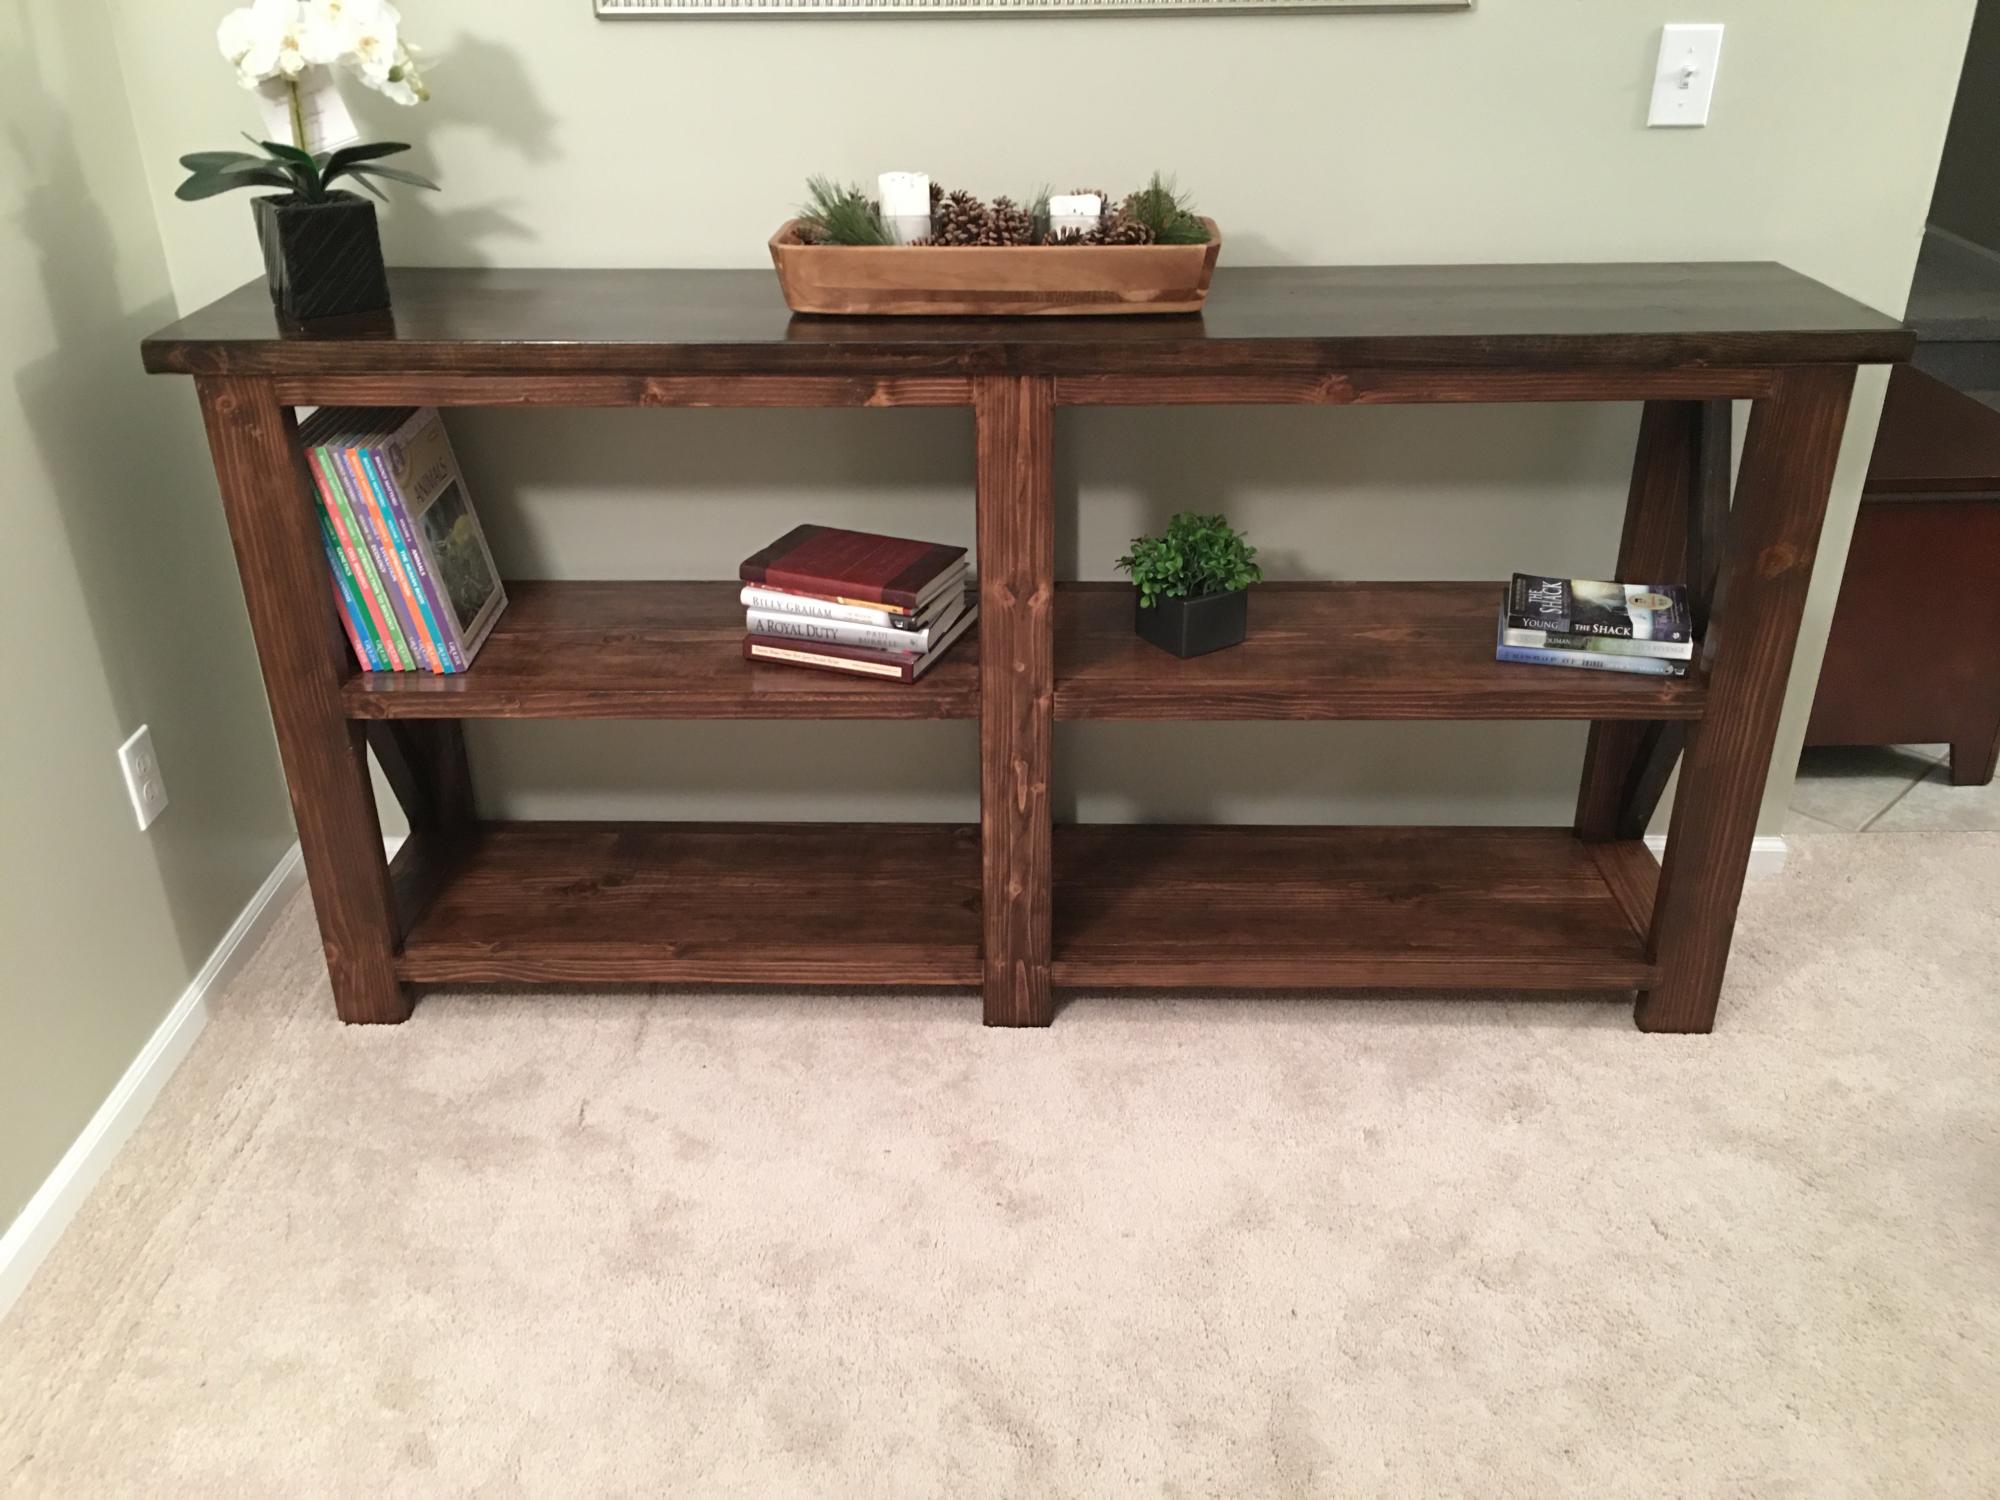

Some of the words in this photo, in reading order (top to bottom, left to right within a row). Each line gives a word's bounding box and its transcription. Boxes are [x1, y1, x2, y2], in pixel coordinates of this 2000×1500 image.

[1528, 589, 1543, 603] THE
[1539, 580, 1562, 615] SHACK
[752, 596, 782, 610] BILLY
[786, 601, 832, 617] GRAHAM
[755, 619, 765, 632] A
[767, 619, 802, 636] ROYAL
[806, 624, 839, 640] DUTY
[1522, 617, 1560, 630] YOUNG
[1575, 624, 1591, 632] THE
[1592, 624, 1632, 636] SHACK
